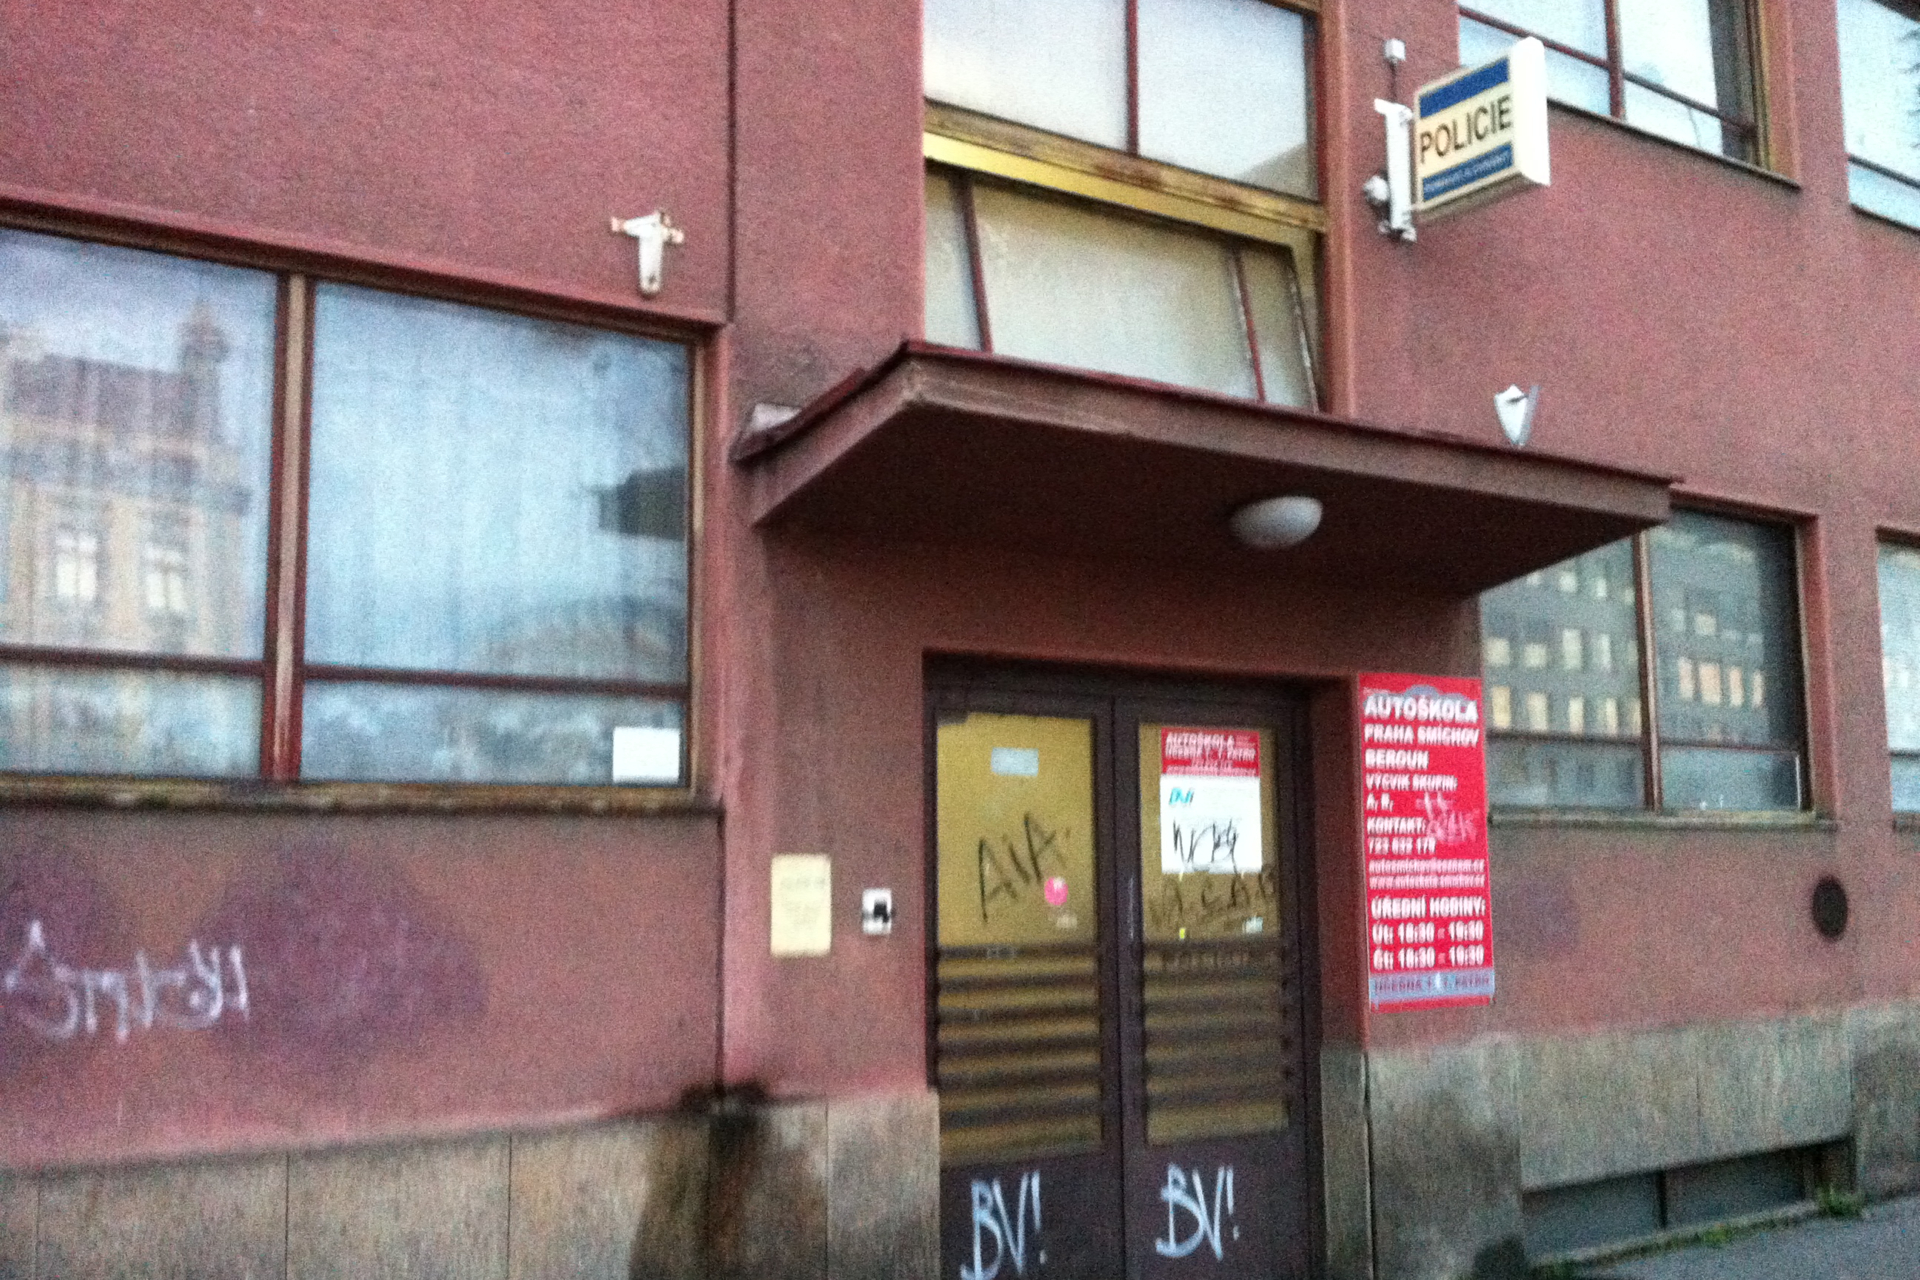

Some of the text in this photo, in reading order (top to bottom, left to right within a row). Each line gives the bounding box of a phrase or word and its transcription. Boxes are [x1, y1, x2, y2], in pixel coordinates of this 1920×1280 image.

[1420, 94, 1512, 167] POLICIE
[1364, 694, 1479, 724] AUTOŠKOLA
[1364, 723, 1415, 745] PRAHA
[1365, 749, 1430, 770] BEROUN
[1366, 817, 1426, 835] KONTAKT:
[1371, 894, 1486, 920] ÚŘEDNÍ HODINY:
